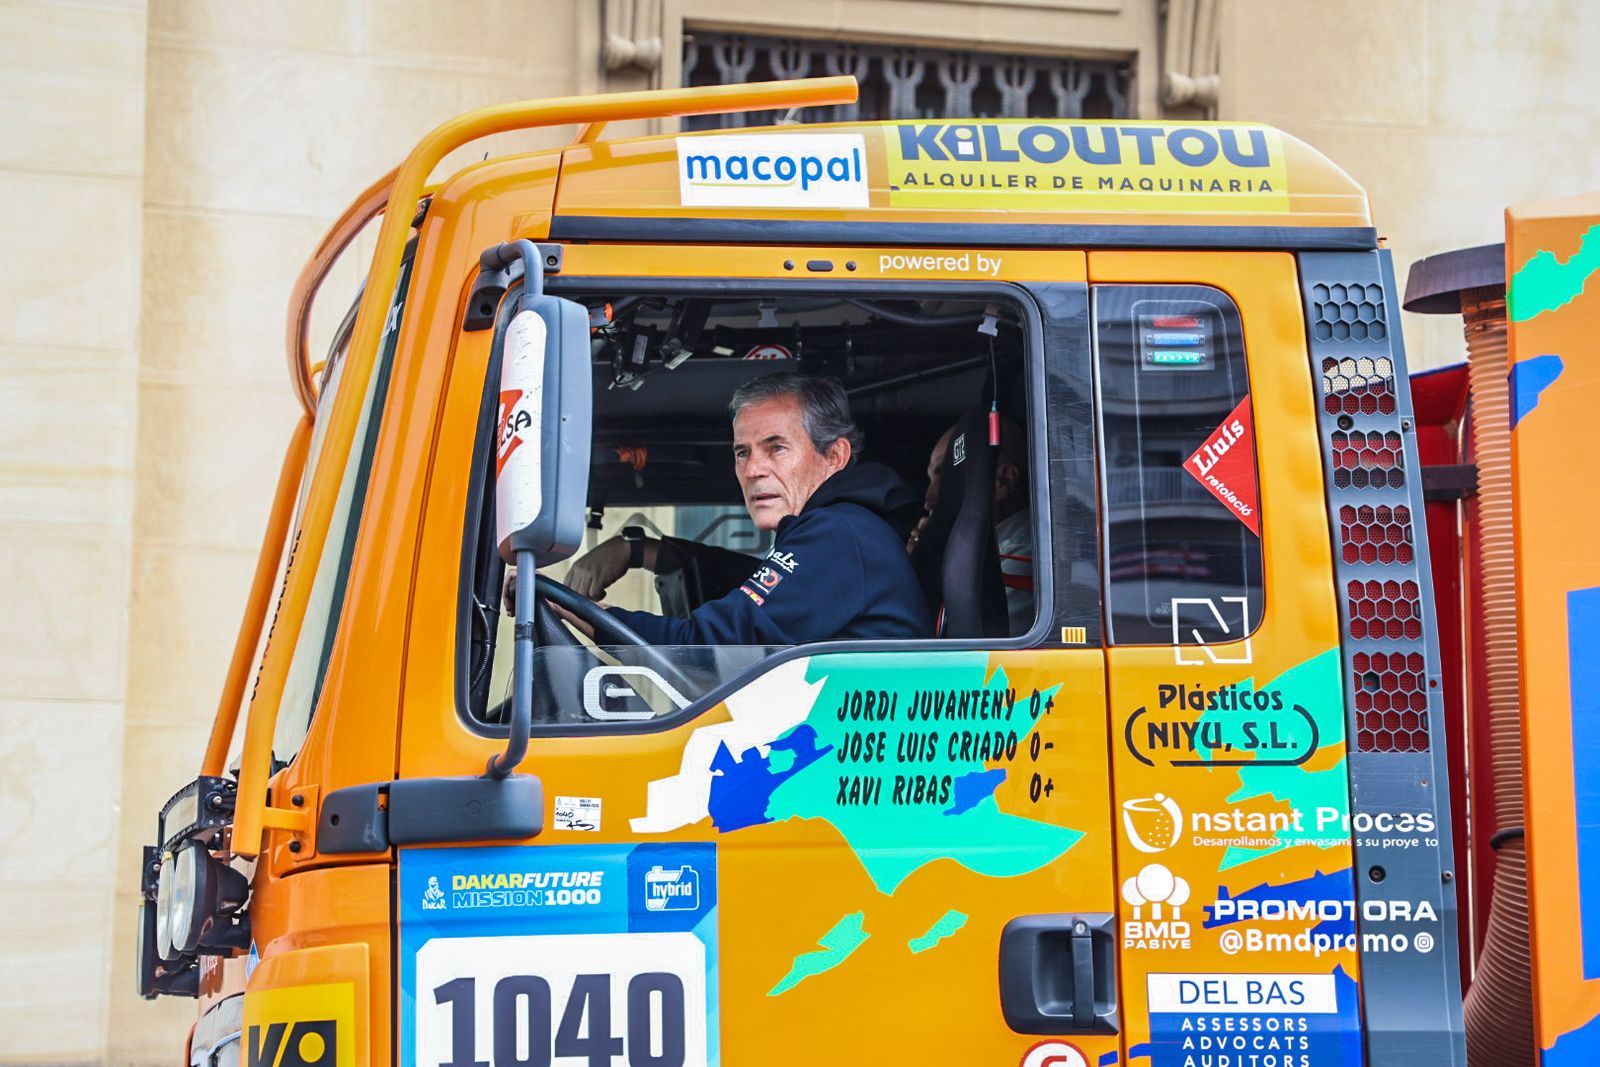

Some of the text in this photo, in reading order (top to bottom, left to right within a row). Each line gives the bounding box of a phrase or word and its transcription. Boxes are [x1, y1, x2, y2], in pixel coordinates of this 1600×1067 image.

[685, 146, 862, 192] macopal
[904, 172, 1274, 193] ALQUILER DE MAQUINARIA
[878, 252, 1002, 277] powered by
[1192, 419, 1245, 477] Lluís
[1205, 474, 1253, 517] retolació
[836, 689, 898, 722] JORDI
[908, 688, 1016, 722] JUVANTENY
[1158, 683, 1284, 712] Plásticos
[836, 731, 887, 763] JOSE
[896, 731, 939, 763] LUIS
[948, 729, 1018, 763] CRIADO
[1147, 722, 1298, 752] NIYU, S.L.
[836, 775, 882, 806] XAVI
[892, 774, 952, 806] RIBAS
[1192, 836, 1282, 847] Desarrollamos
[1284, 838, 1292, 849] y
[1365, 838, 1380, 847] su
[652, 881, 693, 899] hybrid
[1213, 899, 1438, 921] PROMOTORA
[1124, 921, 1191, 939] BMD
[1219, 928, 1409, 958] @Bmdpromo
[1123, 939, 1192, 950] PASIVE
[1179, 980, 1305, 1006] DEL BAS
[432, 971, 686, 1067] 1040
[1181, 1017, 1308, 1032] ASSESSORS
[1182, 1036, 1310, 1051] ADVOCATS
[1183, 1055, 1310, 1067] AUDITORS
